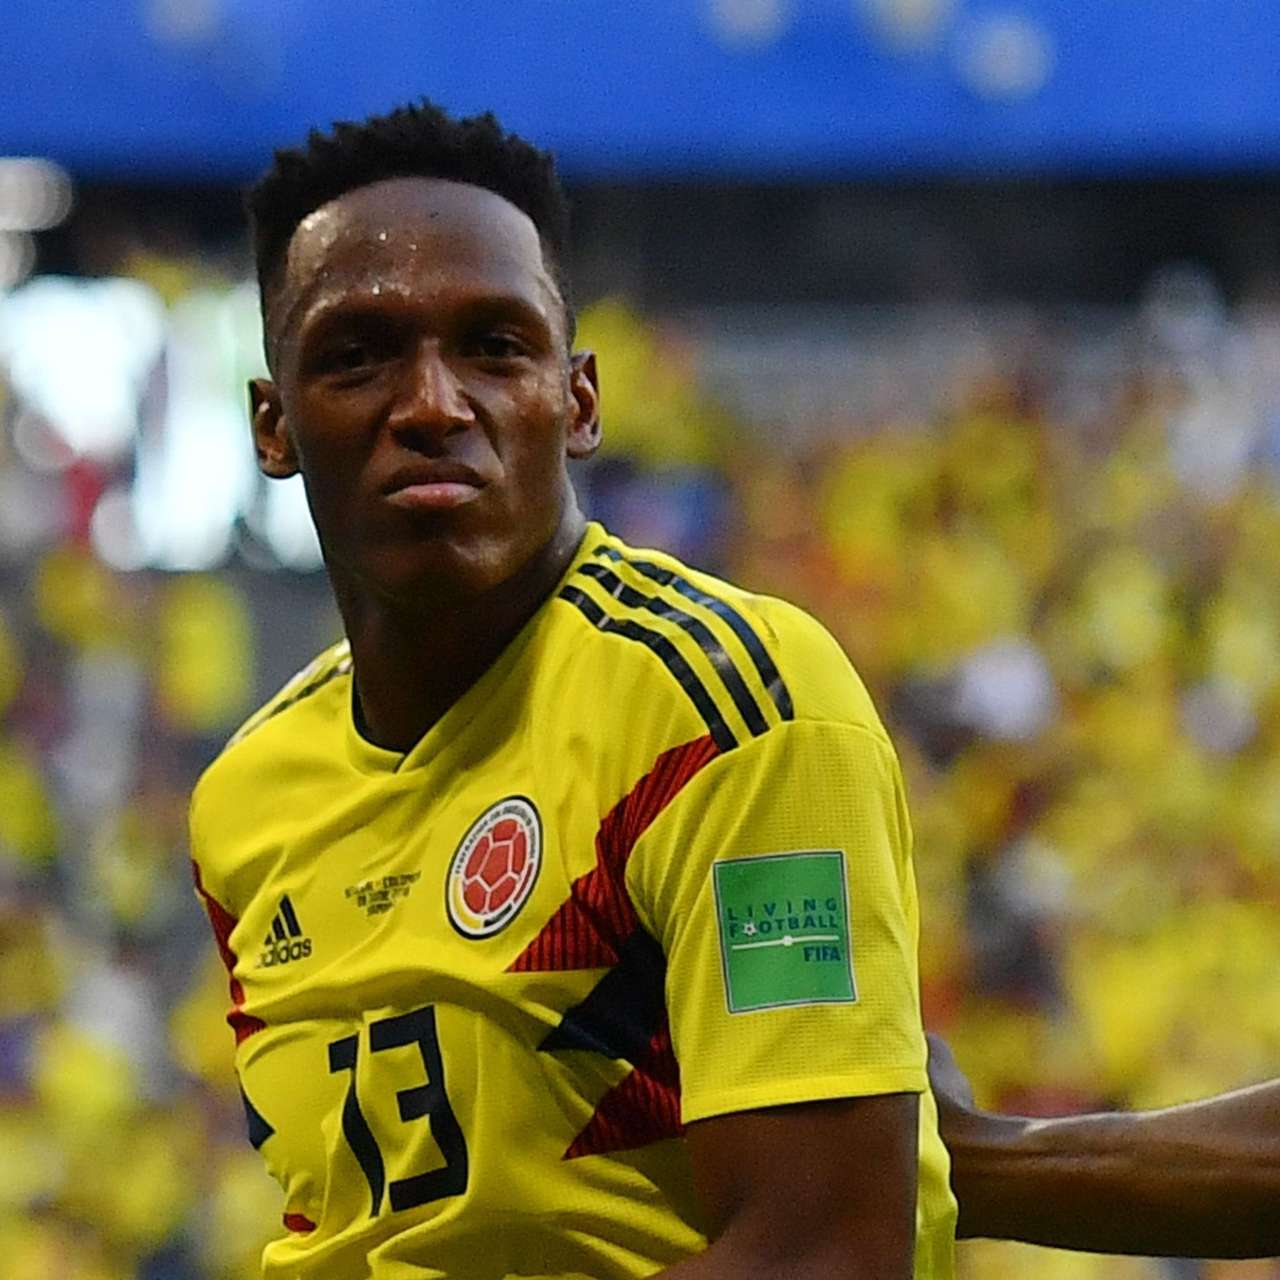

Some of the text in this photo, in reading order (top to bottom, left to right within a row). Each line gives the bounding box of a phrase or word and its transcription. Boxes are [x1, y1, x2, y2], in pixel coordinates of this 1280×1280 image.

[727, 898, 838, 921] LIVING
[804, 946, 841, 962] FIFA
[328, 1004, 468, 1219] 13
